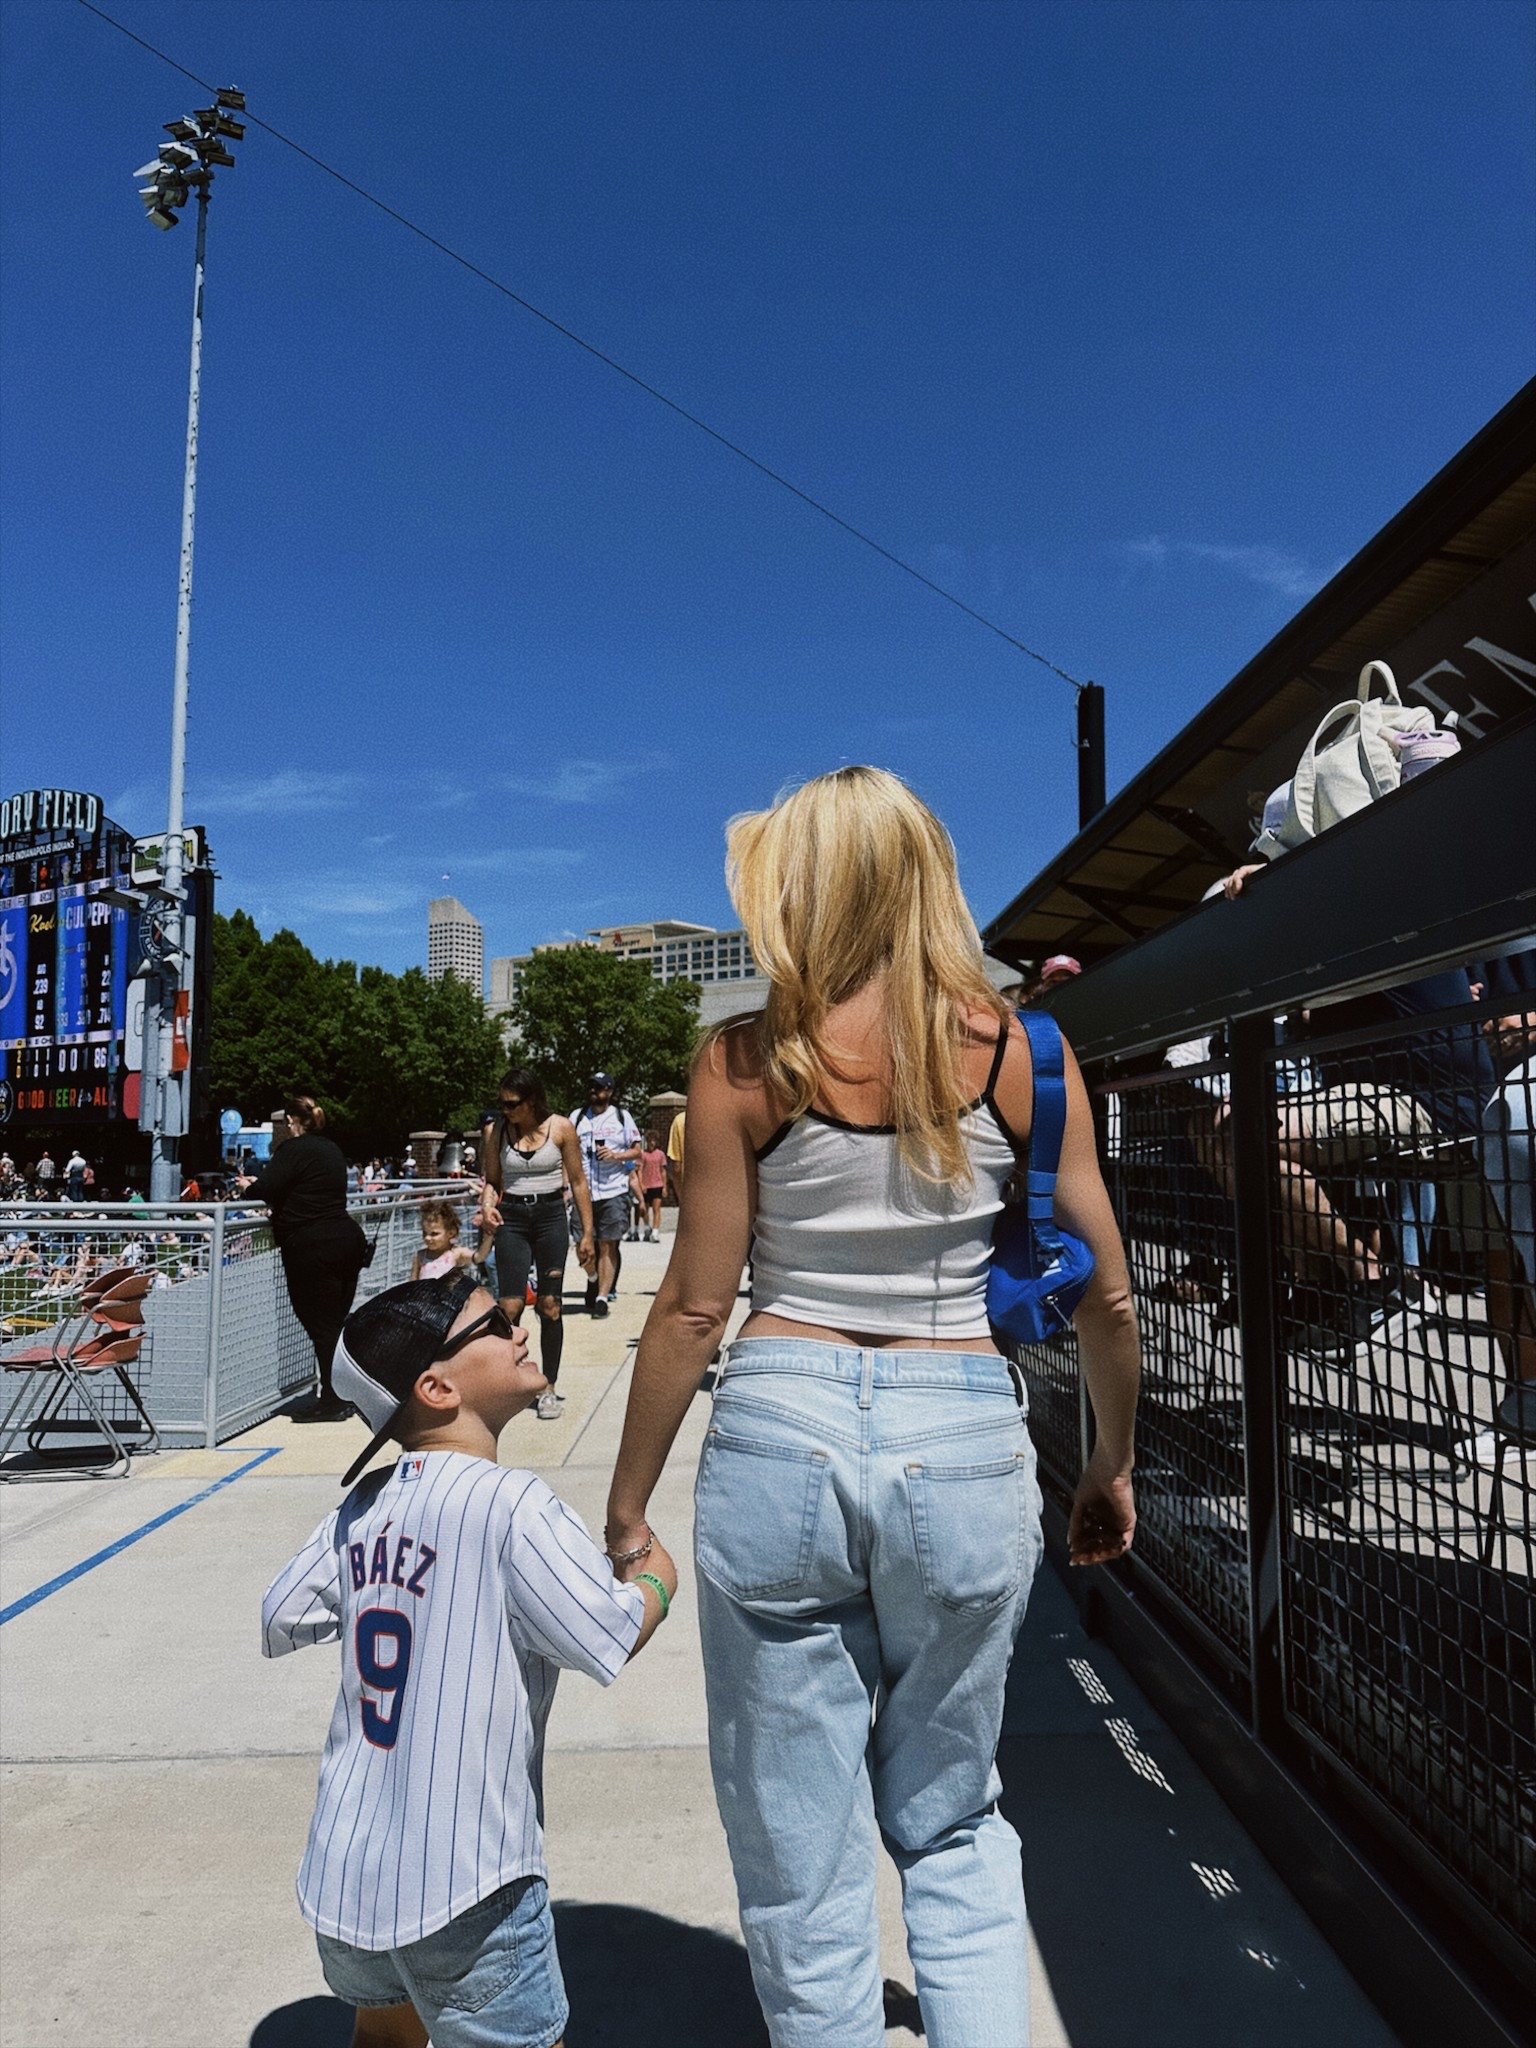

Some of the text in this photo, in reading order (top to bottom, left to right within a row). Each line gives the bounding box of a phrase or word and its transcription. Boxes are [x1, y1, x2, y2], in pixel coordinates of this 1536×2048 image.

[39, 789, 97, 833] FIELD
[5, 852, 15, 863] THE
[15, 843, 52, 861] INDIANAPOLIS
[52, 838, 75, 852] INDIANS
[18, 1090, 45, 1110] GOOD
[349, 1520, 437, 1598] BÁEZ
[355, 1607, 412, 1750] 9
